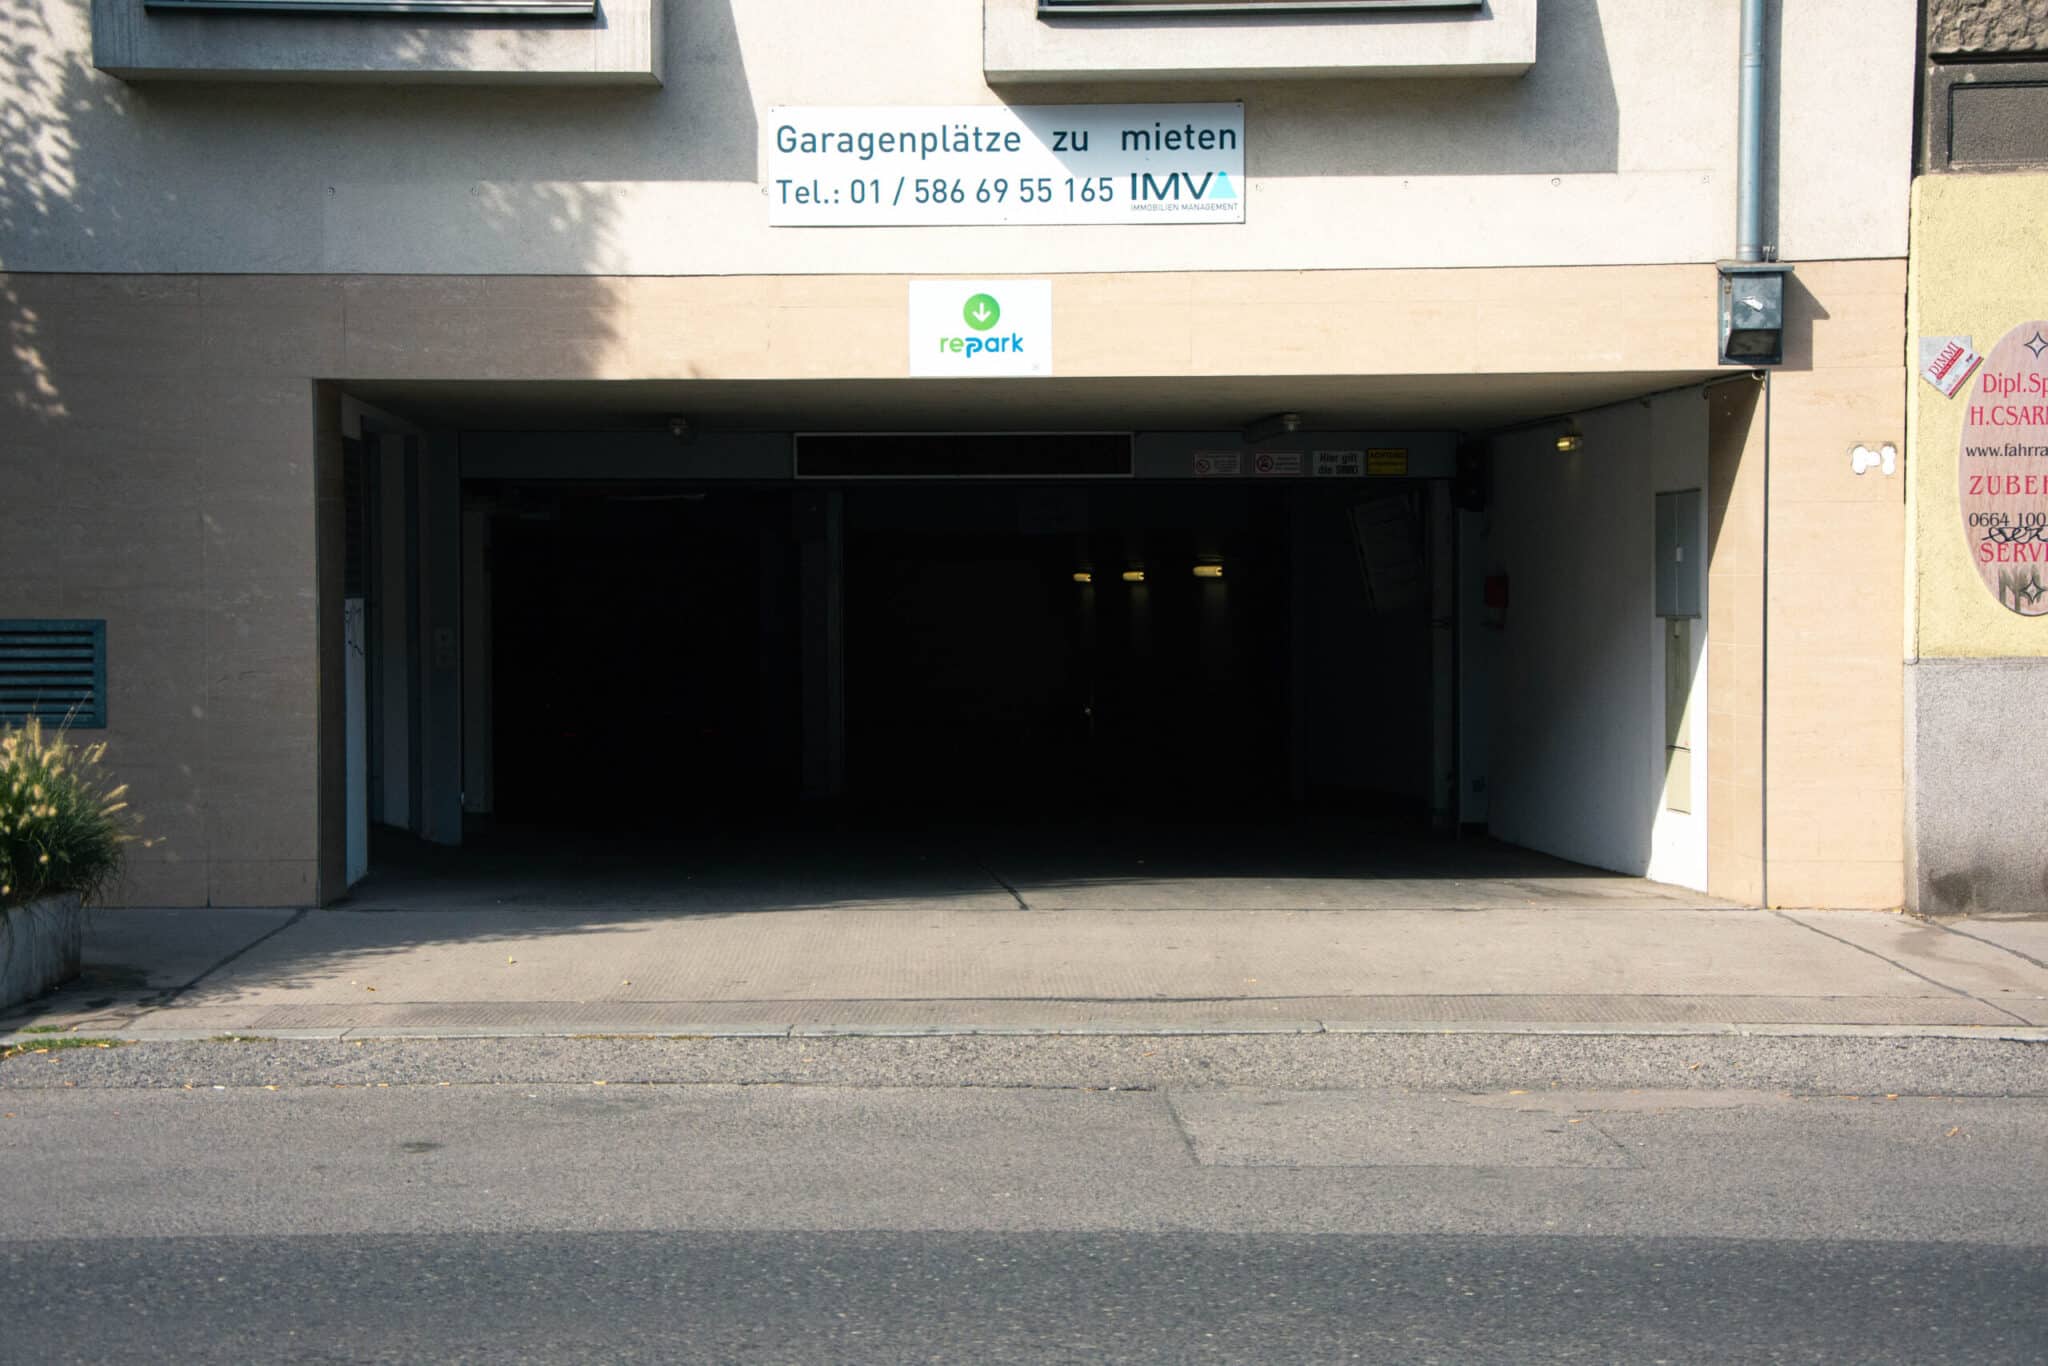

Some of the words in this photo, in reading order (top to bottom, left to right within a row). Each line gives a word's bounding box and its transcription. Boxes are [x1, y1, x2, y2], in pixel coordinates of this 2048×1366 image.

[776, 124, 1021, 161] Garagenplätze
[1052, 130, 1089, 151] zu
[1121, 122, 1236, 150] mieten
[776, 179, 840, 204] Tel.:
[850, 179, 880, 204] 01
[892, 176, 905, 206] /
[915, 178, 965, 203] 586
[976, 178, 1009, 203] 69
[1019, 177, 1052, 203] 55
[1064, 177, 1113, 202] 165
[1130, 203, 1179, 211] IMMOBILIEN
[1181, 202, 1238, 211] MANAGEMENT
[938, 331, 1024, 359] repark
[1968, 512, 2010, 527] 0664
